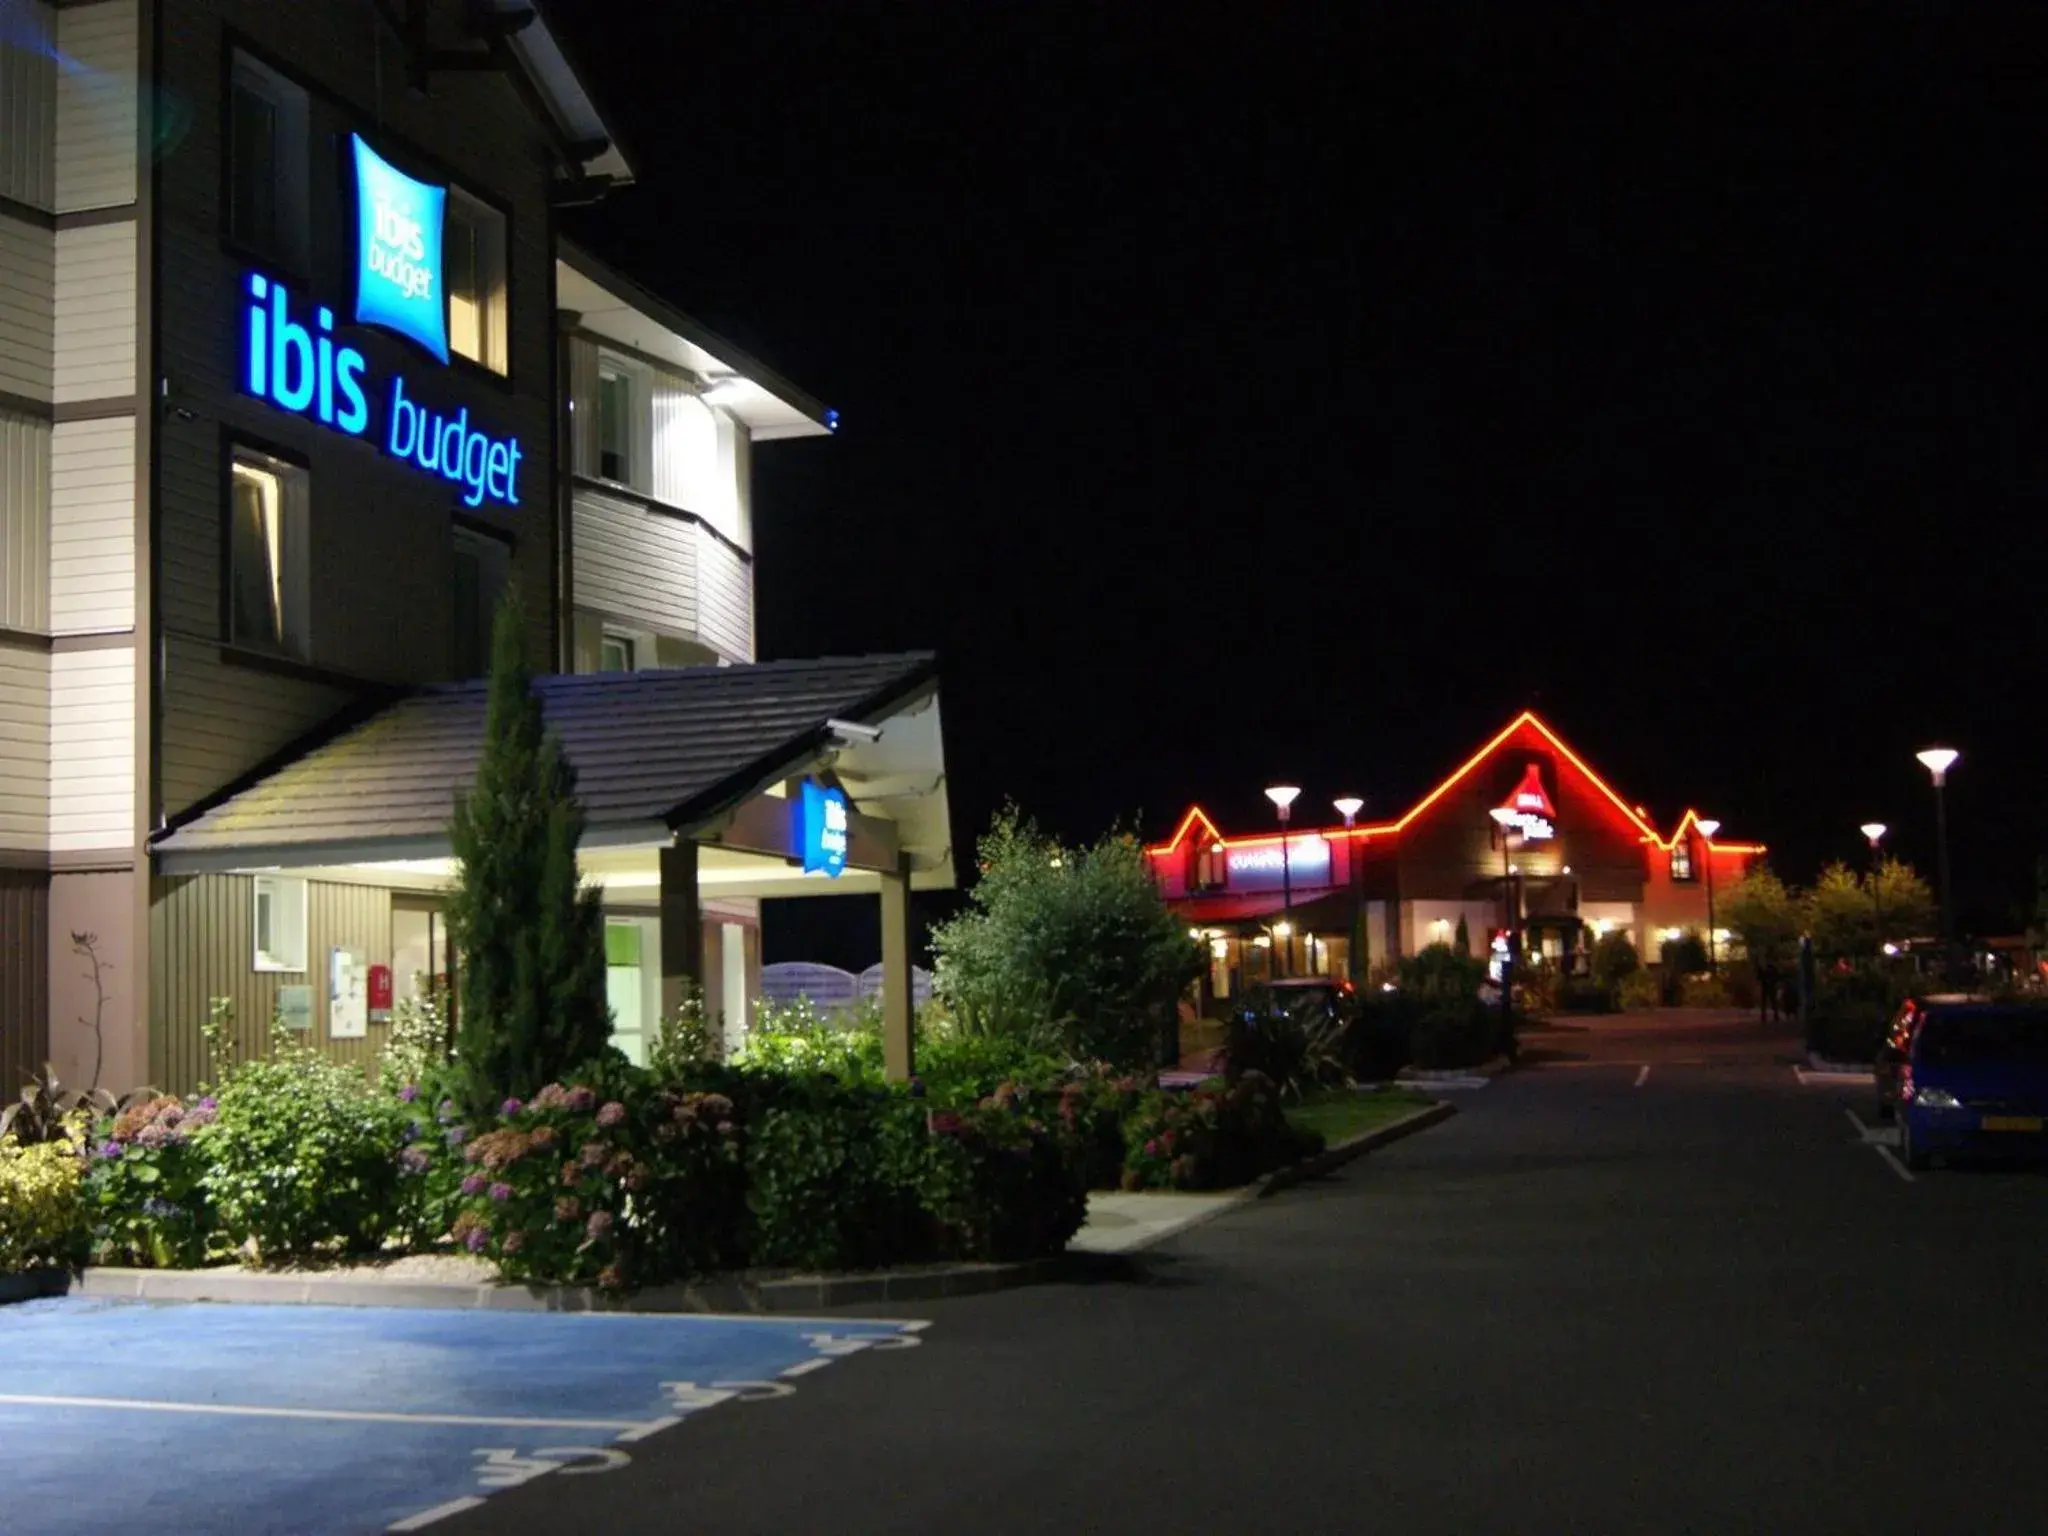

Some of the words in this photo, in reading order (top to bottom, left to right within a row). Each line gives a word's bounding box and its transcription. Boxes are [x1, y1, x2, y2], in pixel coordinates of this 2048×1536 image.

[374, 190, 425, 260] ibis
[368, 235, 433, 299] budget
[249, 273, 369, 435] ibis
[390, 376, 523, 507] budget
